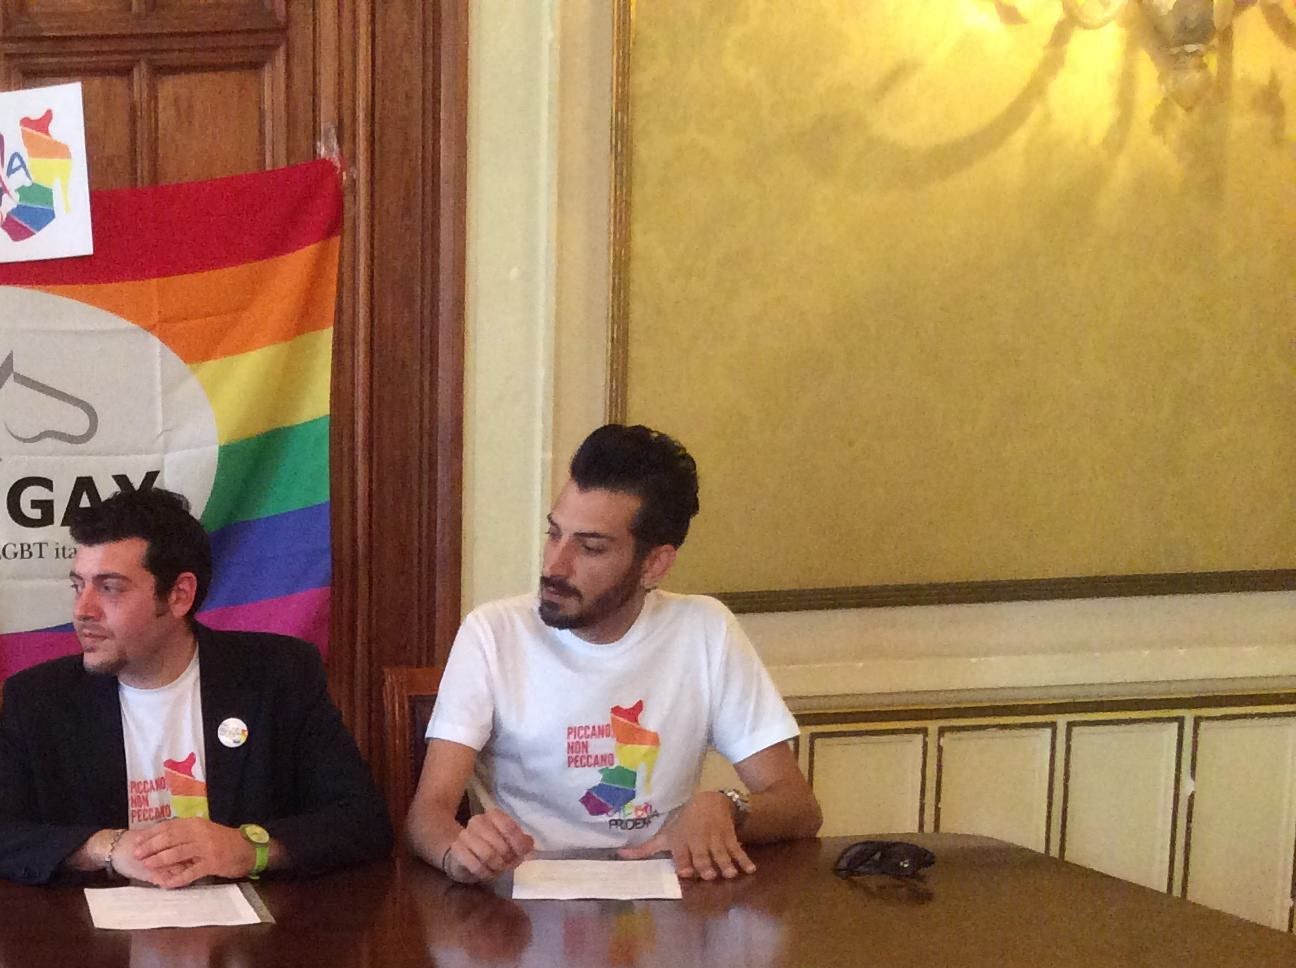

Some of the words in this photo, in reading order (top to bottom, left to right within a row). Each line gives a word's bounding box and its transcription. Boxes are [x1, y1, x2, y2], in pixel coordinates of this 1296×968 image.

[567, 741, 589, 754] NON
[567, 753, 615, 768] PECCANO
[131, 805, 171, 823] PECCANO
